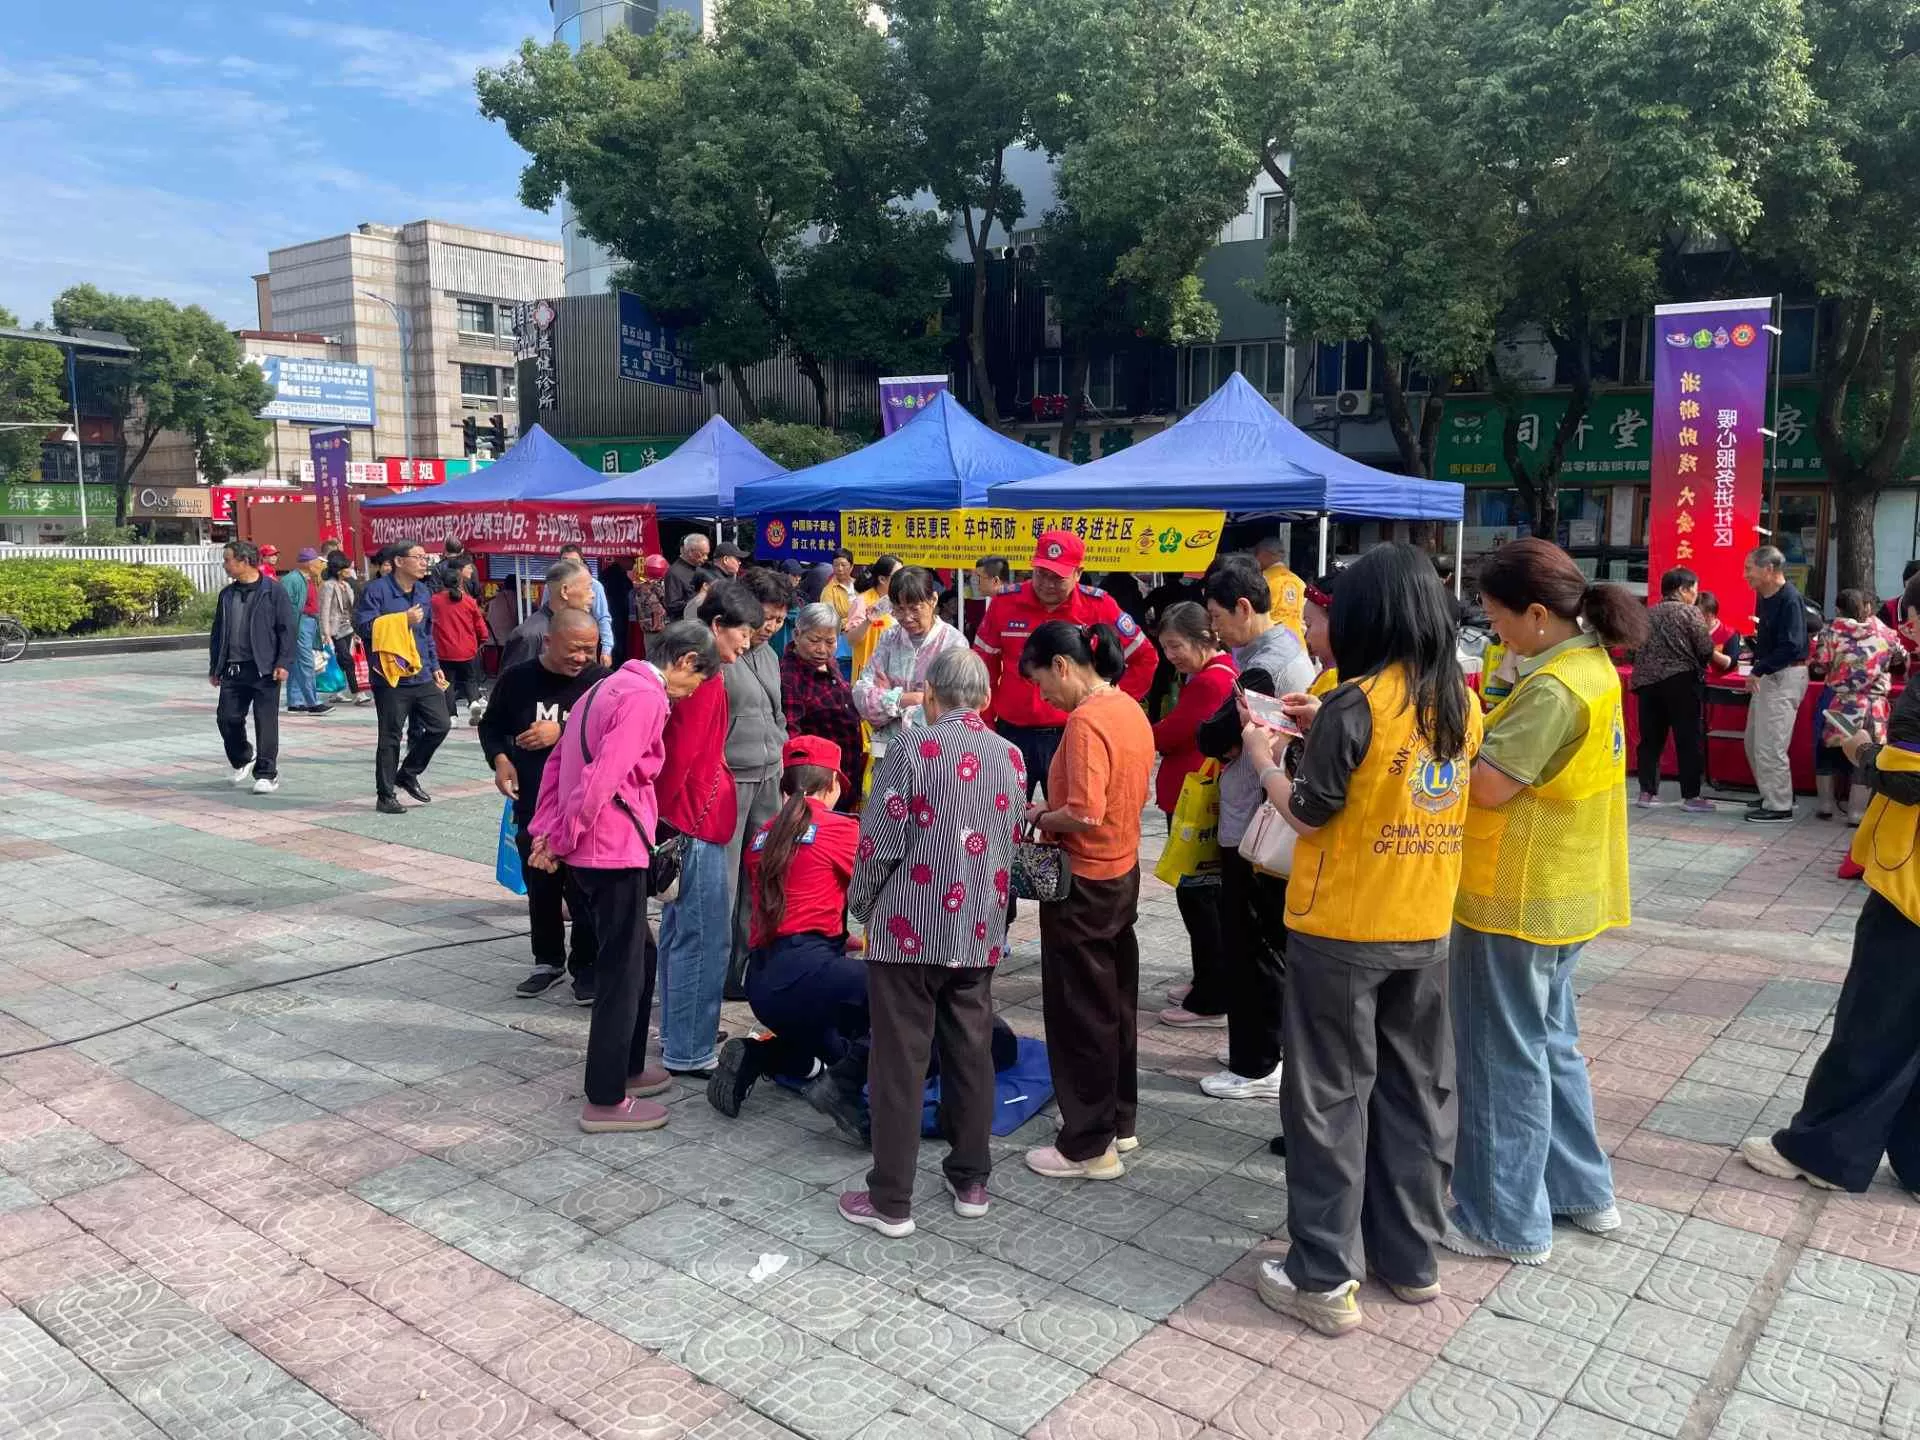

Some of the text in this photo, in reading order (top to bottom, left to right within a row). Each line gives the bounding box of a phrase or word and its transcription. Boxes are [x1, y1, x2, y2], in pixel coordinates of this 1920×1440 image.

[1381, 823, 1420, 838] CHINA
[1373, 840, 1393, 854] OF
[1396, 839, 1435, 855] LIONS
